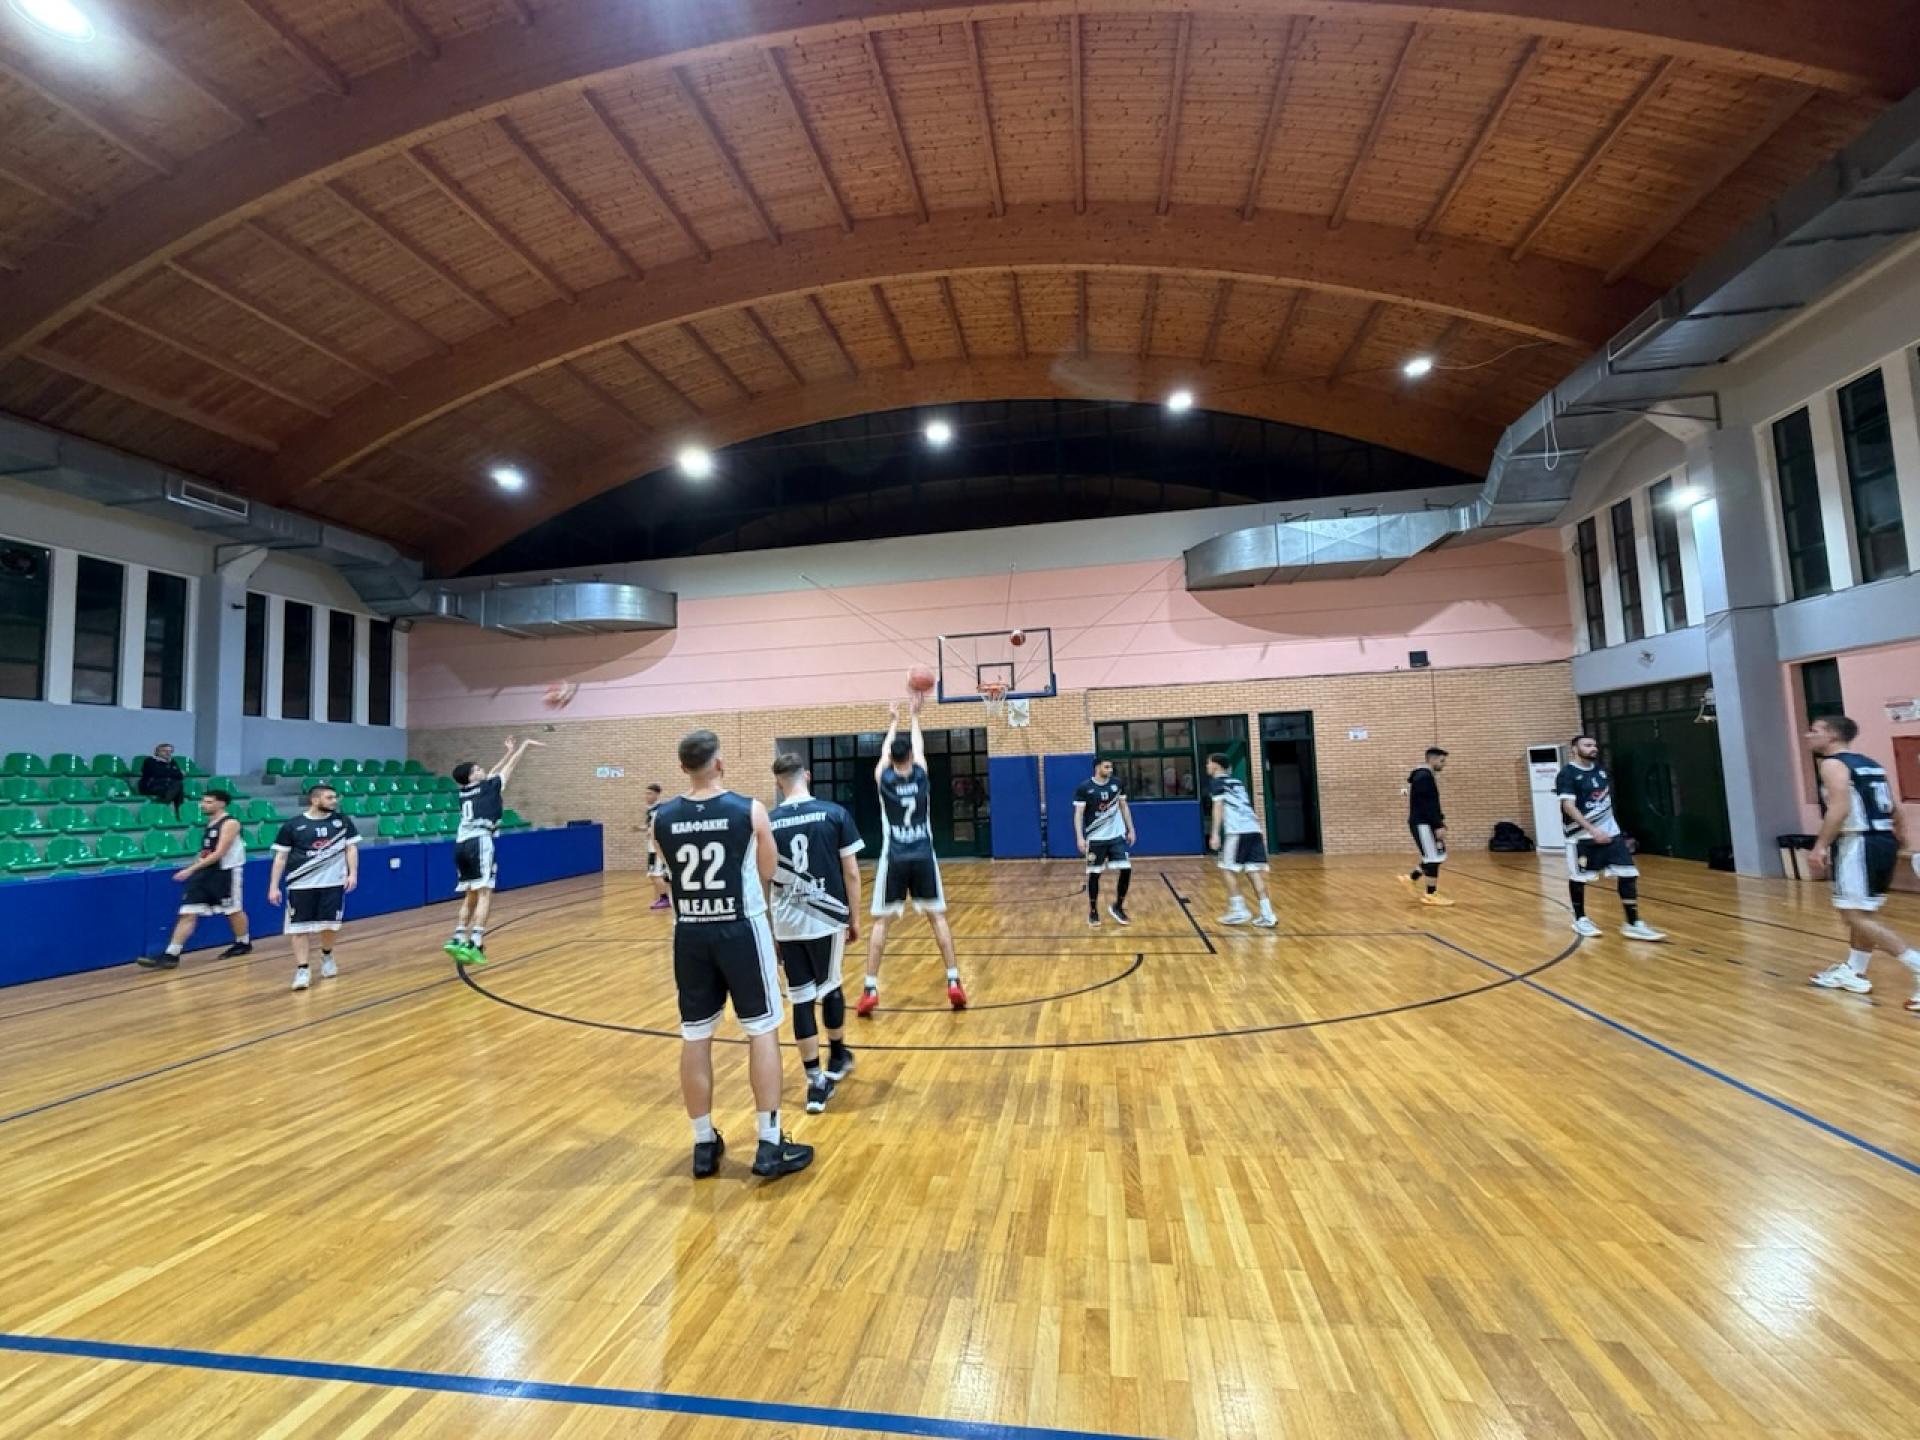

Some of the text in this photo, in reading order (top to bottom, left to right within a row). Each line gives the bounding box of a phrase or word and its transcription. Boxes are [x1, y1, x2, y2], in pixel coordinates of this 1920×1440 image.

[671, 818, 729, 834] ΚΑΛΦΑΚΗΣ
[901, 797, 916, 827] 7
[676, 841, 726, 891] 22
[790, 833, 809, 873] 8
